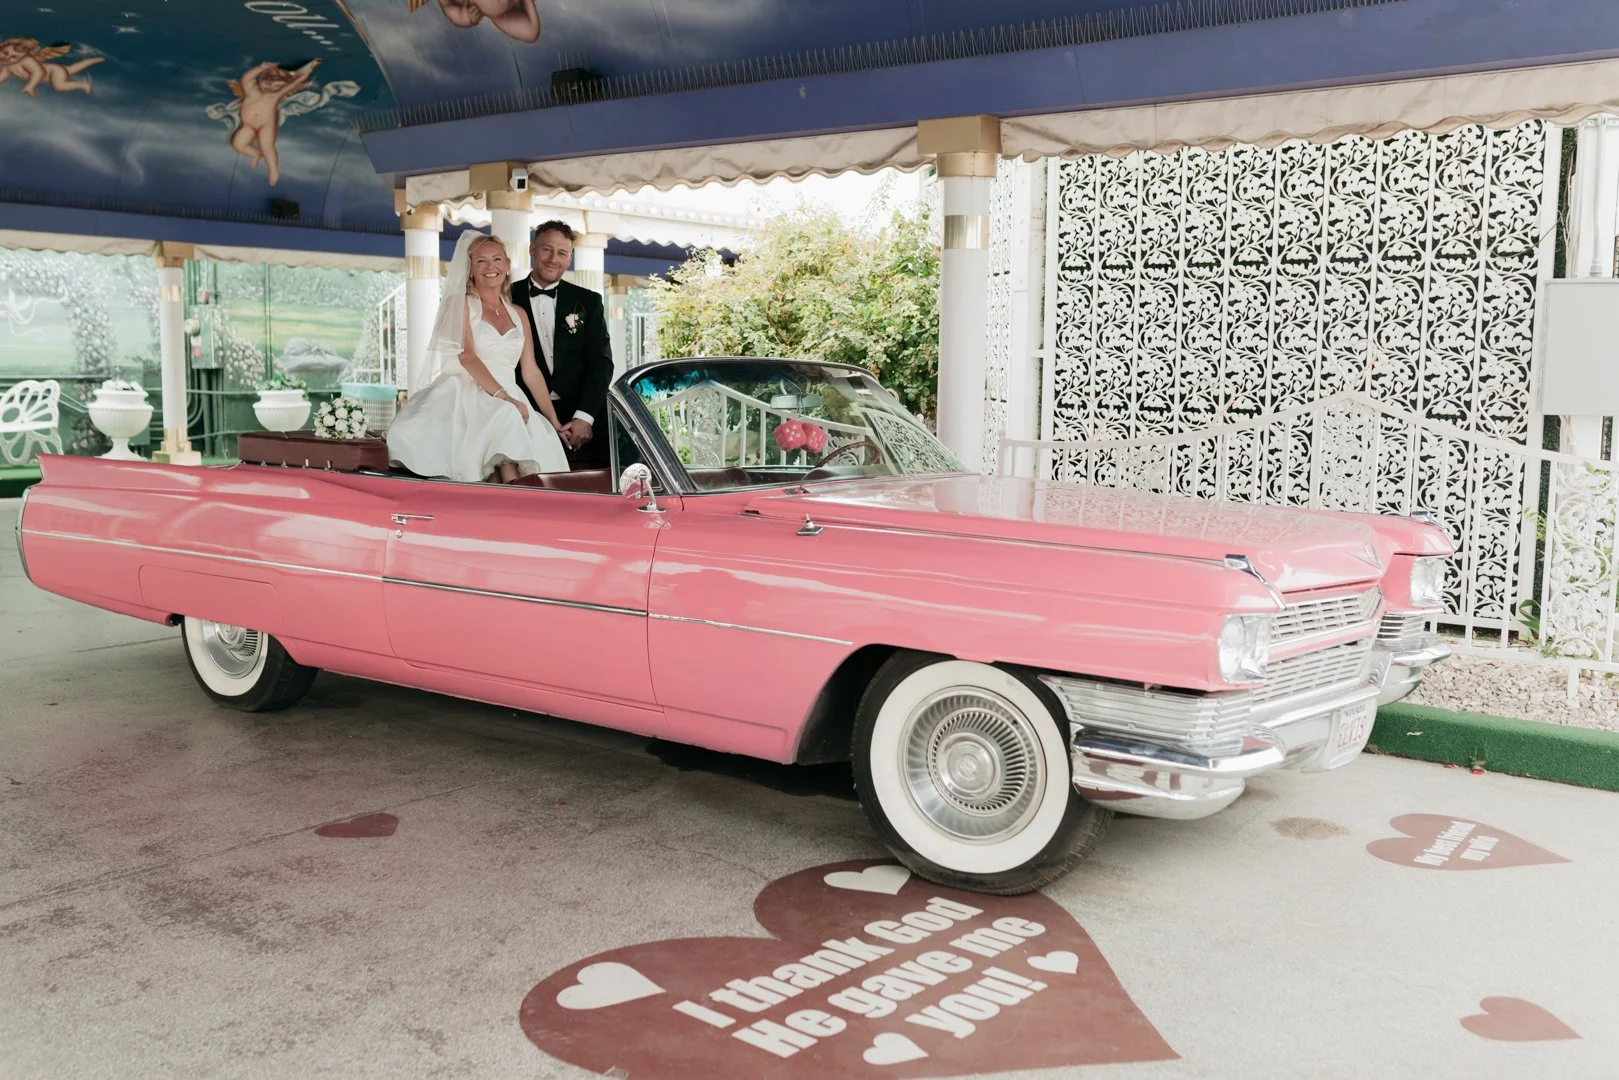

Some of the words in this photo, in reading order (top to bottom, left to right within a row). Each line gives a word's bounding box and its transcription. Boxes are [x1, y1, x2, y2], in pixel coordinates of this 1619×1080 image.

[1423, 837, 1461, 857] best
[1436, 820, 1477, 842] friend
[672, 1000, 736, 1028] I
[709, 936, 896, 1013] thank
[863, 896, 984, 944] God
[731, 1009, 847, 1058] He
[827, 950, 973, 1018] gave
[949, 916, 1046, 958] me
[904, 966, 1048, 1039] you!
